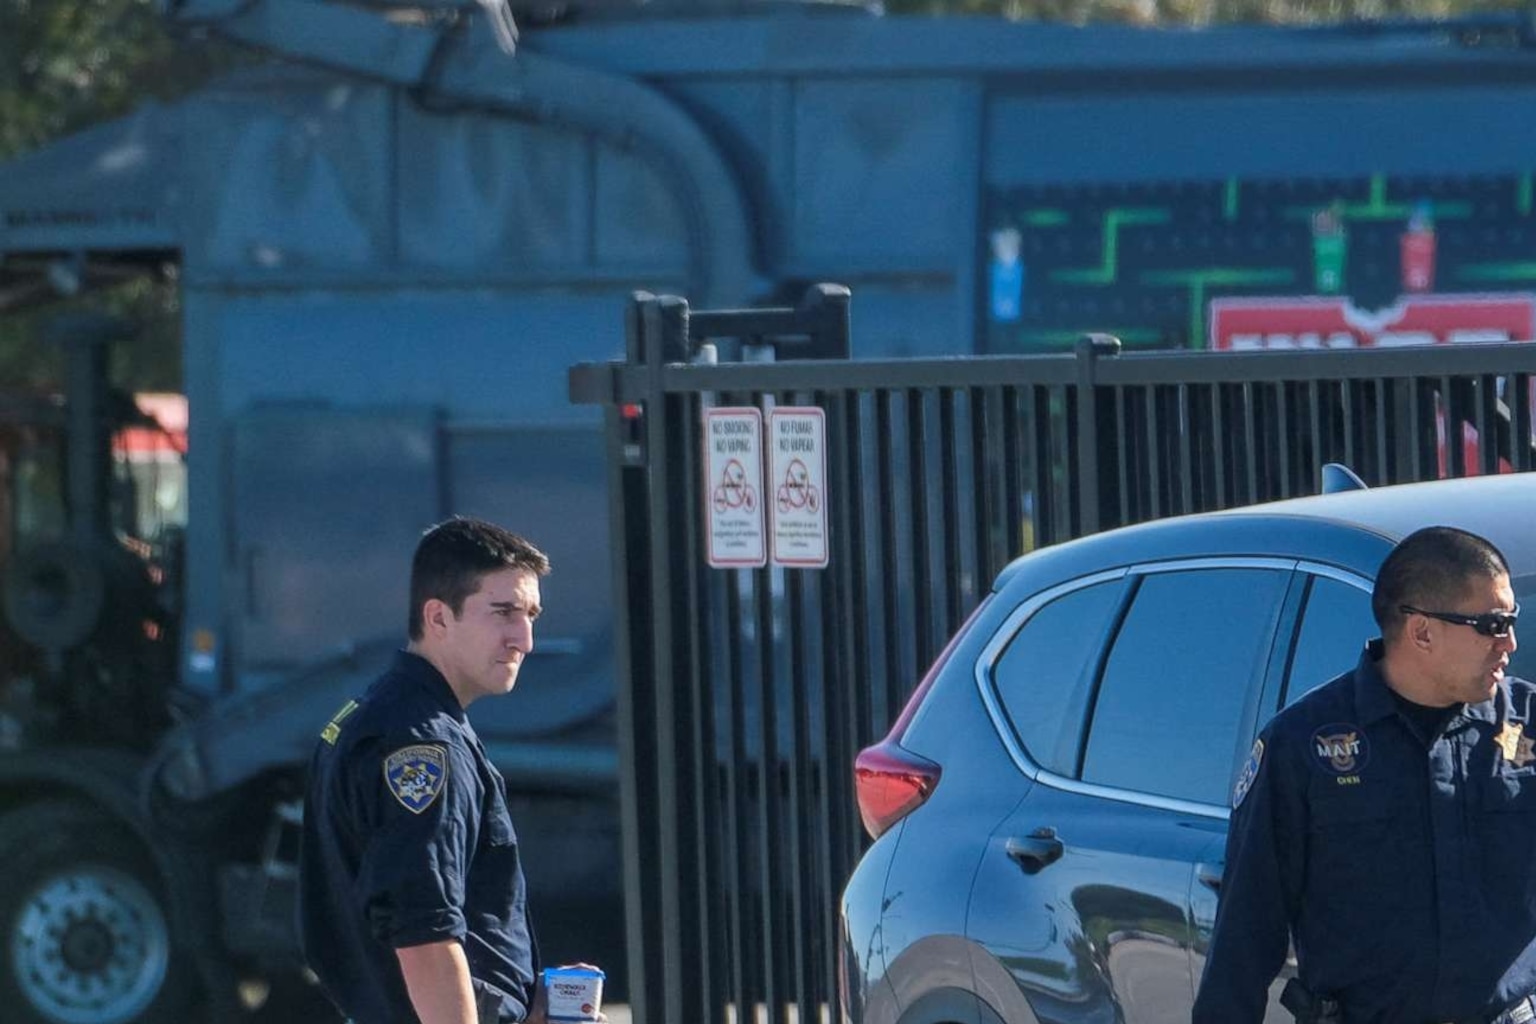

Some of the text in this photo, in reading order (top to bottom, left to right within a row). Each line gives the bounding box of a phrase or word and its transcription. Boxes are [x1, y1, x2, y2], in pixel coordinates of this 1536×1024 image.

[712, 420, 723, 434] NO
[779, 420, 790, 434] NO
[716, 439, 726, 453] NO
[779, 439, 789, 453] NO
[1316, 740, 1360, 757] MAIT
